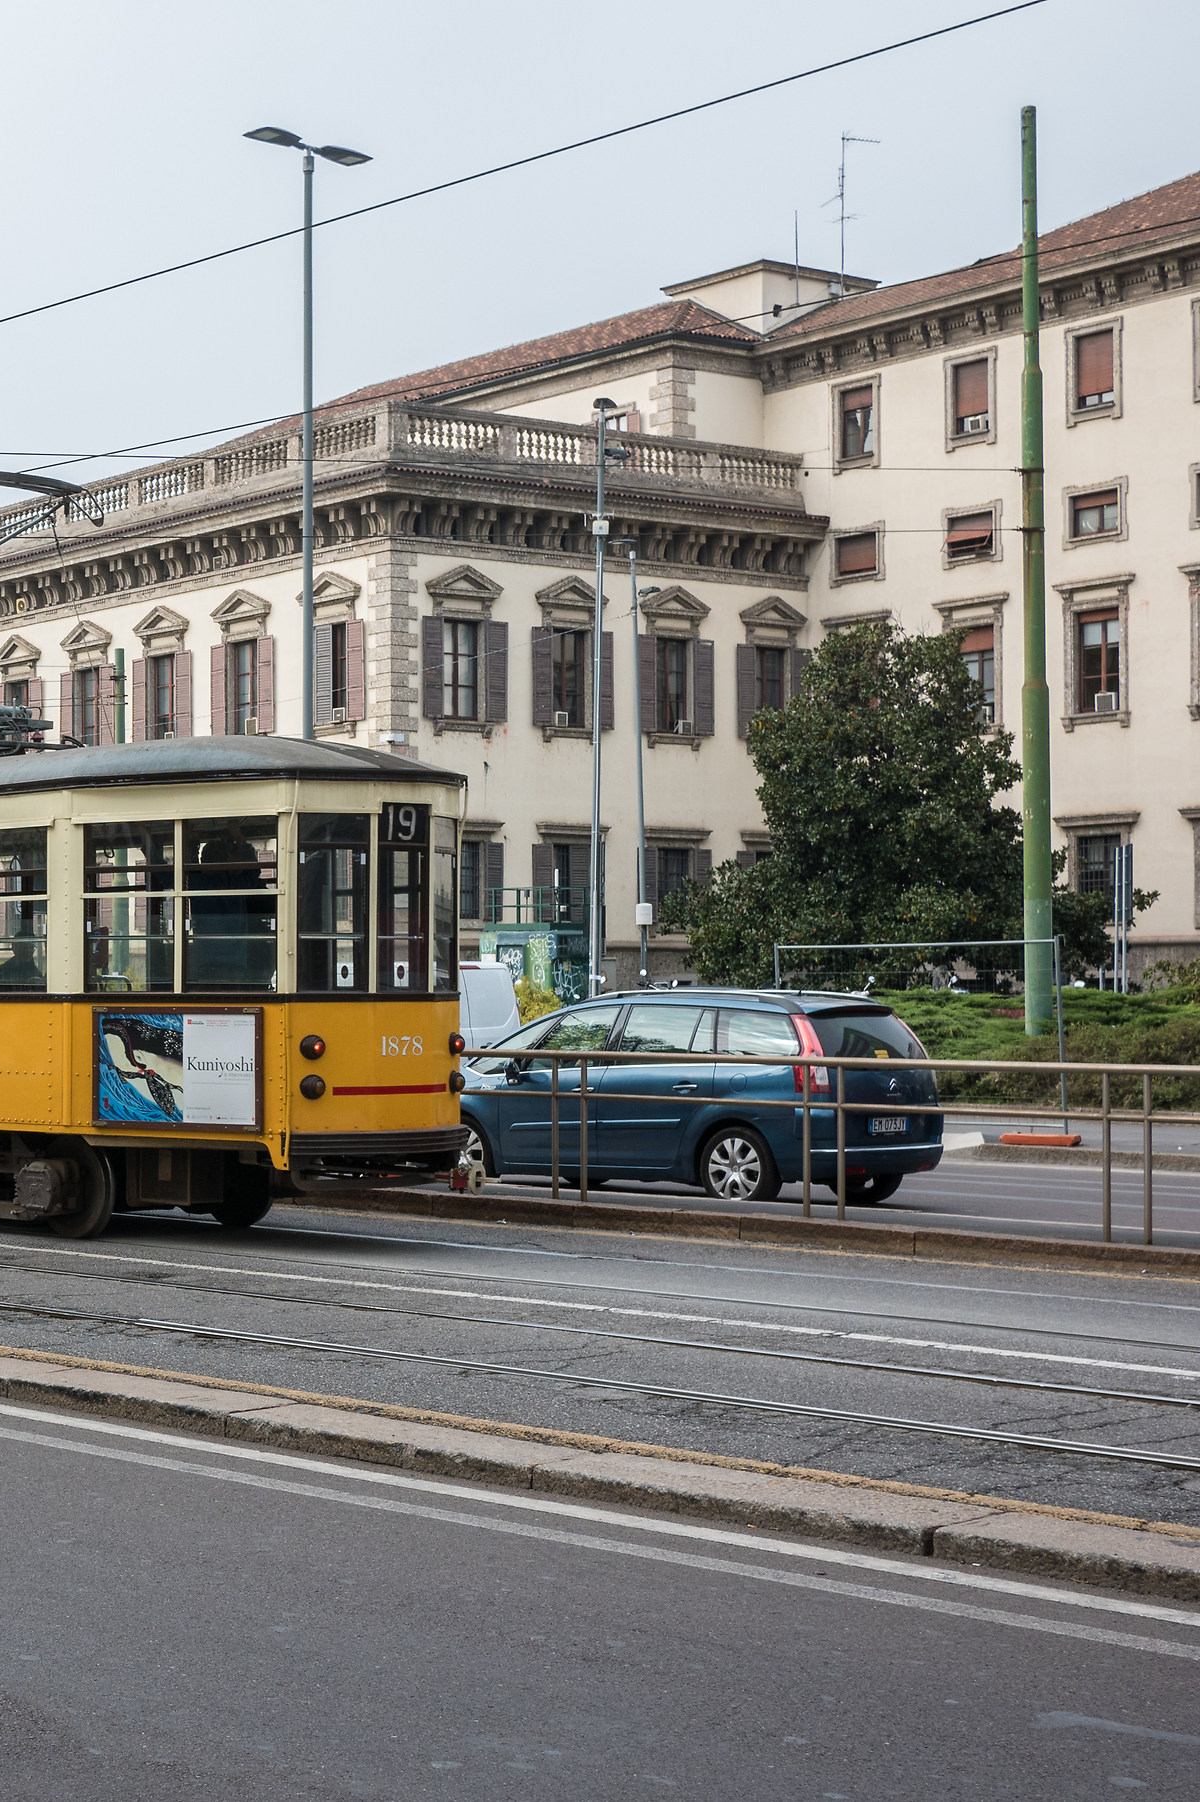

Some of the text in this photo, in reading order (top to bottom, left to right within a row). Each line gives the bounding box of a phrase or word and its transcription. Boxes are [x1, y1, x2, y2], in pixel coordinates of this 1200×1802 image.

[387, 805, 417, 841] 19
[381, 1035, 424, 1057] 1878
[187, 1056, 254, 1078] Kuniyoshi
[874, 1119, 883, 1131] EM
